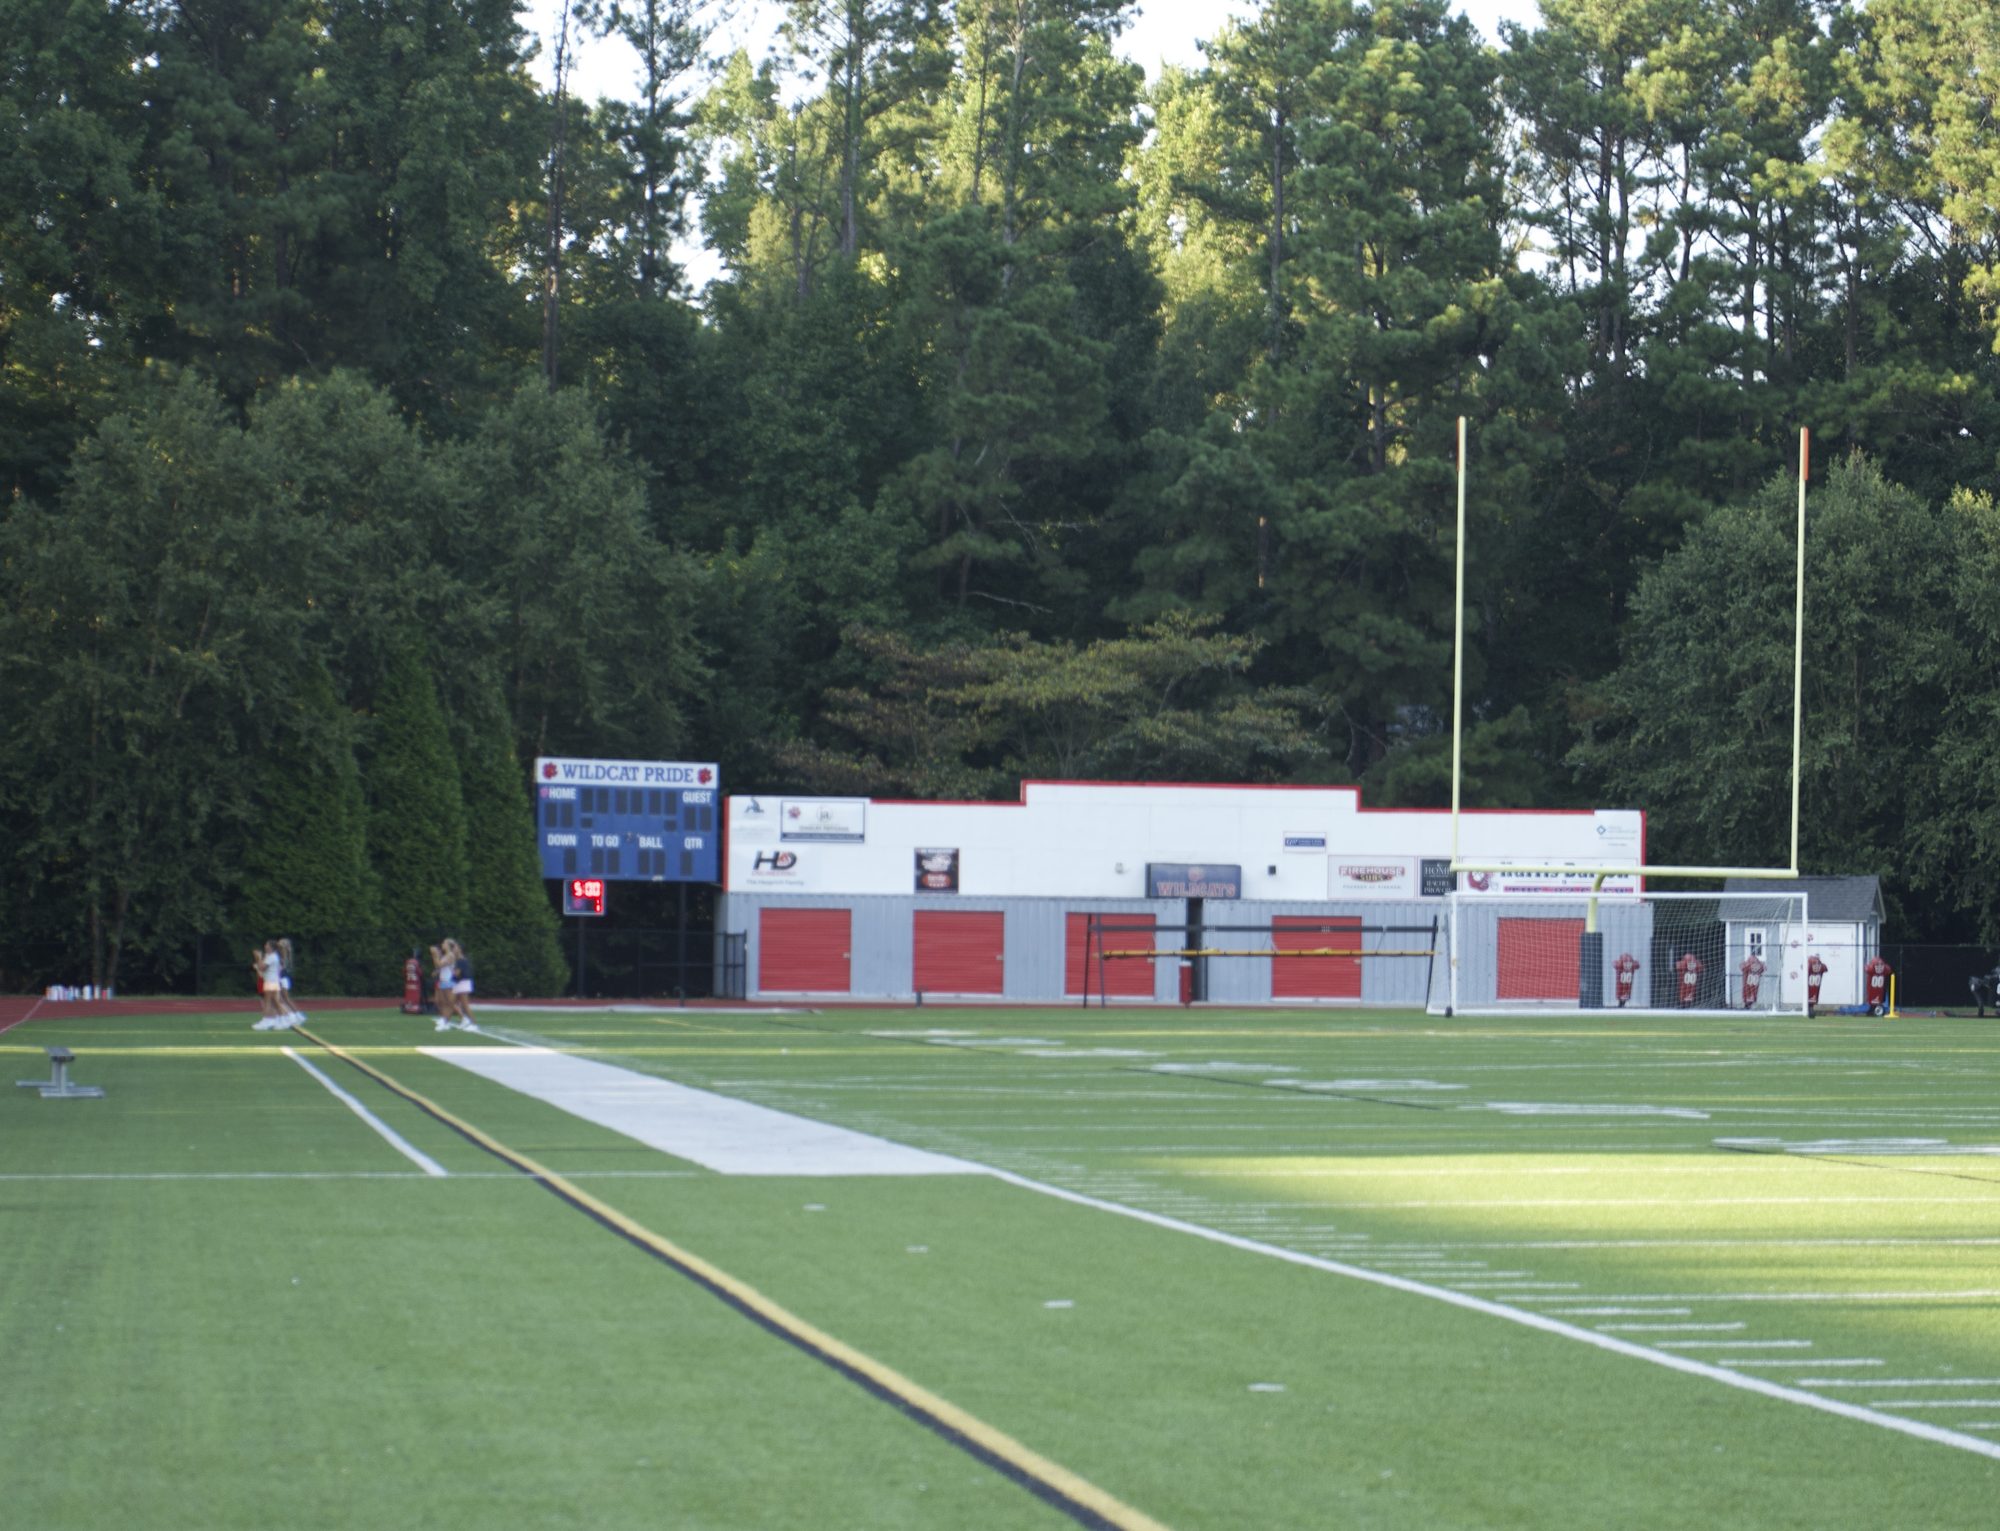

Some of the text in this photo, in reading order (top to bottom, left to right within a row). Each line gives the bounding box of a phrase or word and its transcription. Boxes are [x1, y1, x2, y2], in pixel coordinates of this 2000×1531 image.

[562, 763, 694, 783] WILDCAT PRIDE
[549, 787, 577, 800] HOME
[682, 790, 712, 804] GUEST
[547, 834, 577, 846] DOWN
[591, 834, 619, 848] TO GO
[639, 836, 664, 849] BALL
[684, 837, 703, 850] QTR
[1339, 866, 1404, 876] FIREHOUSE
[1156, 881, 1236, 897] WILDCATS
[1620, 972, 1632, 984] 00
[1684, 972, 1697, 984] 00
[1747, 974, 1759, 986] 00
[1808, 974, 1820, 986] 00
[1871, 975, 1884, 988] 00
